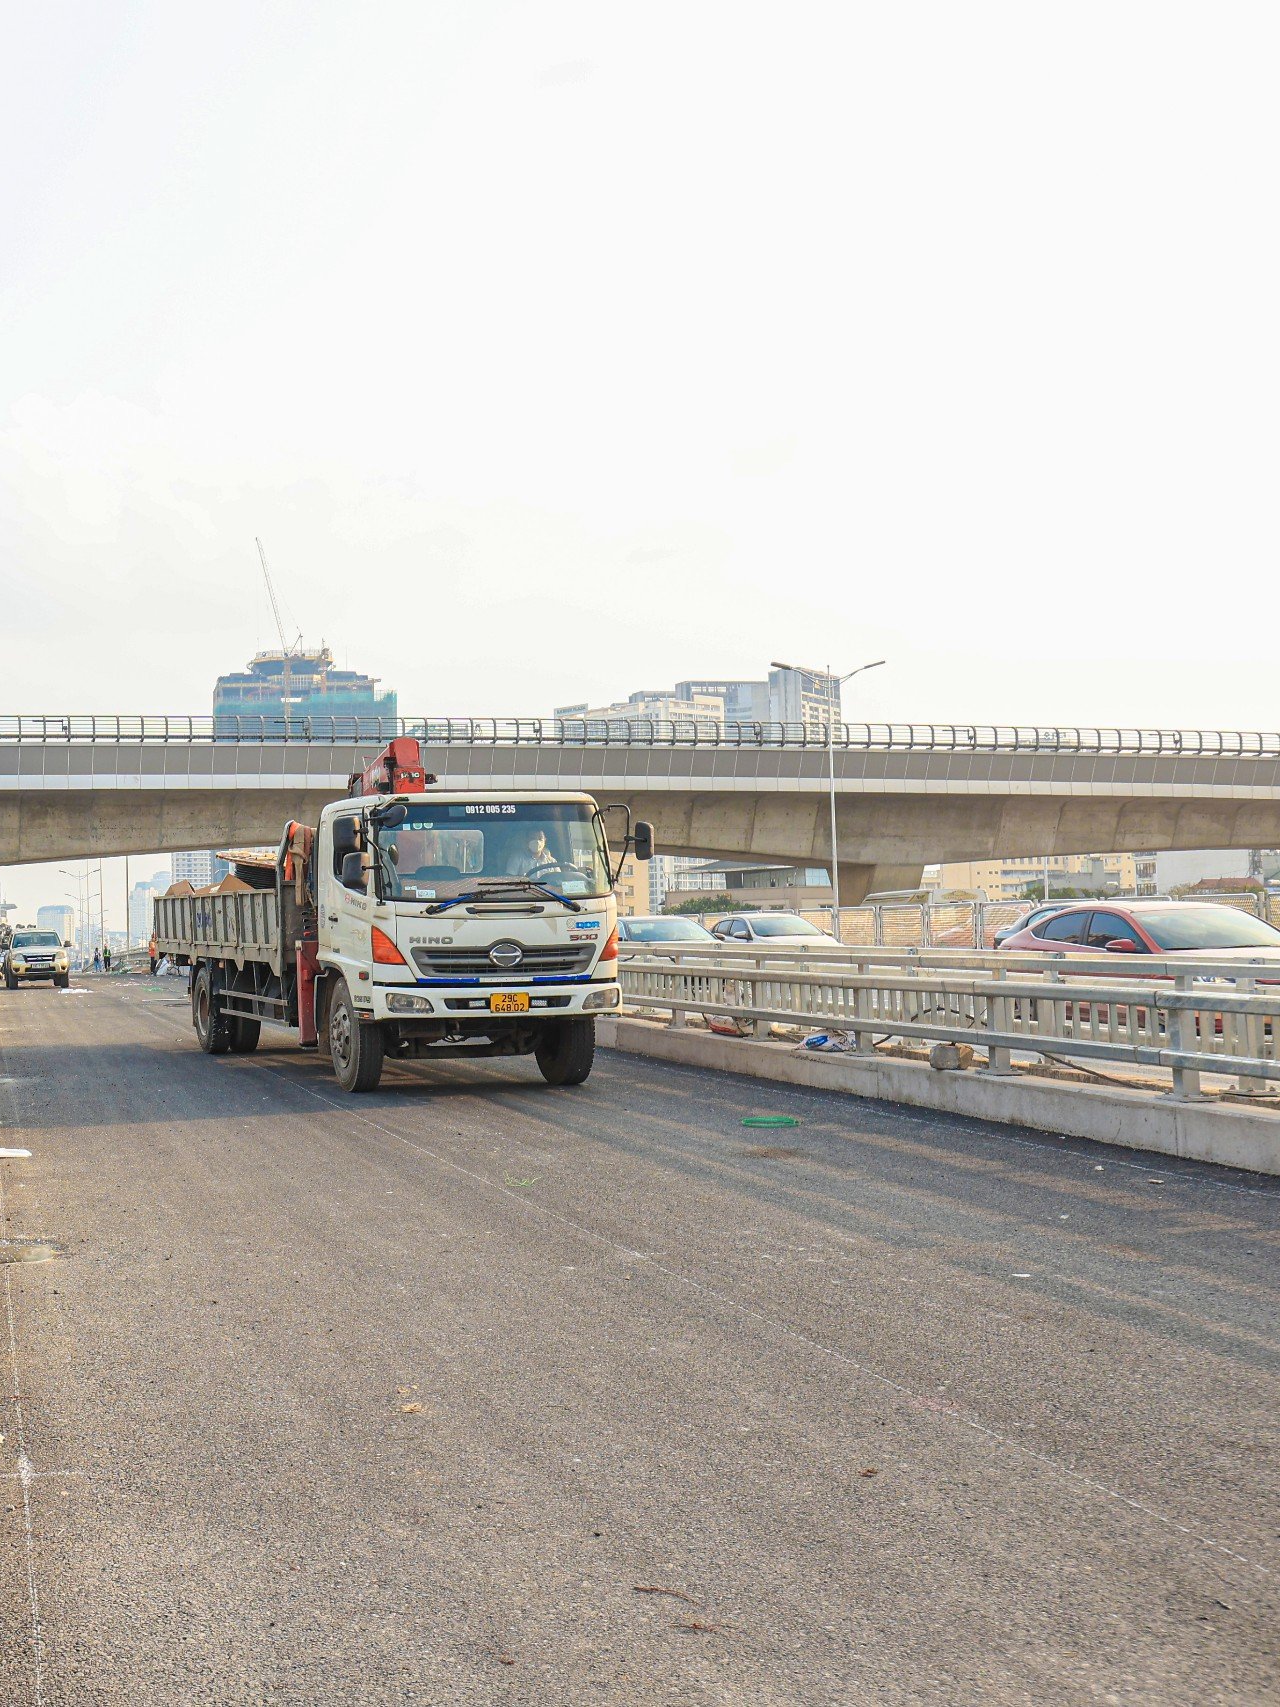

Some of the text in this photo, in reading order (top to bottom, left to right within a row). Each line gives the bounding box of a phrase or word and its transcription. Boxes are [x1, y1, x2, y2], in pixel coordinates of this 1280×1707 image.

[465, 804, 516, 814] 0912 005 235
[409, 936, 453, 945] HINO
[570, 933, 598, 941] 500
[501, 994, 518, 1003] 29C
